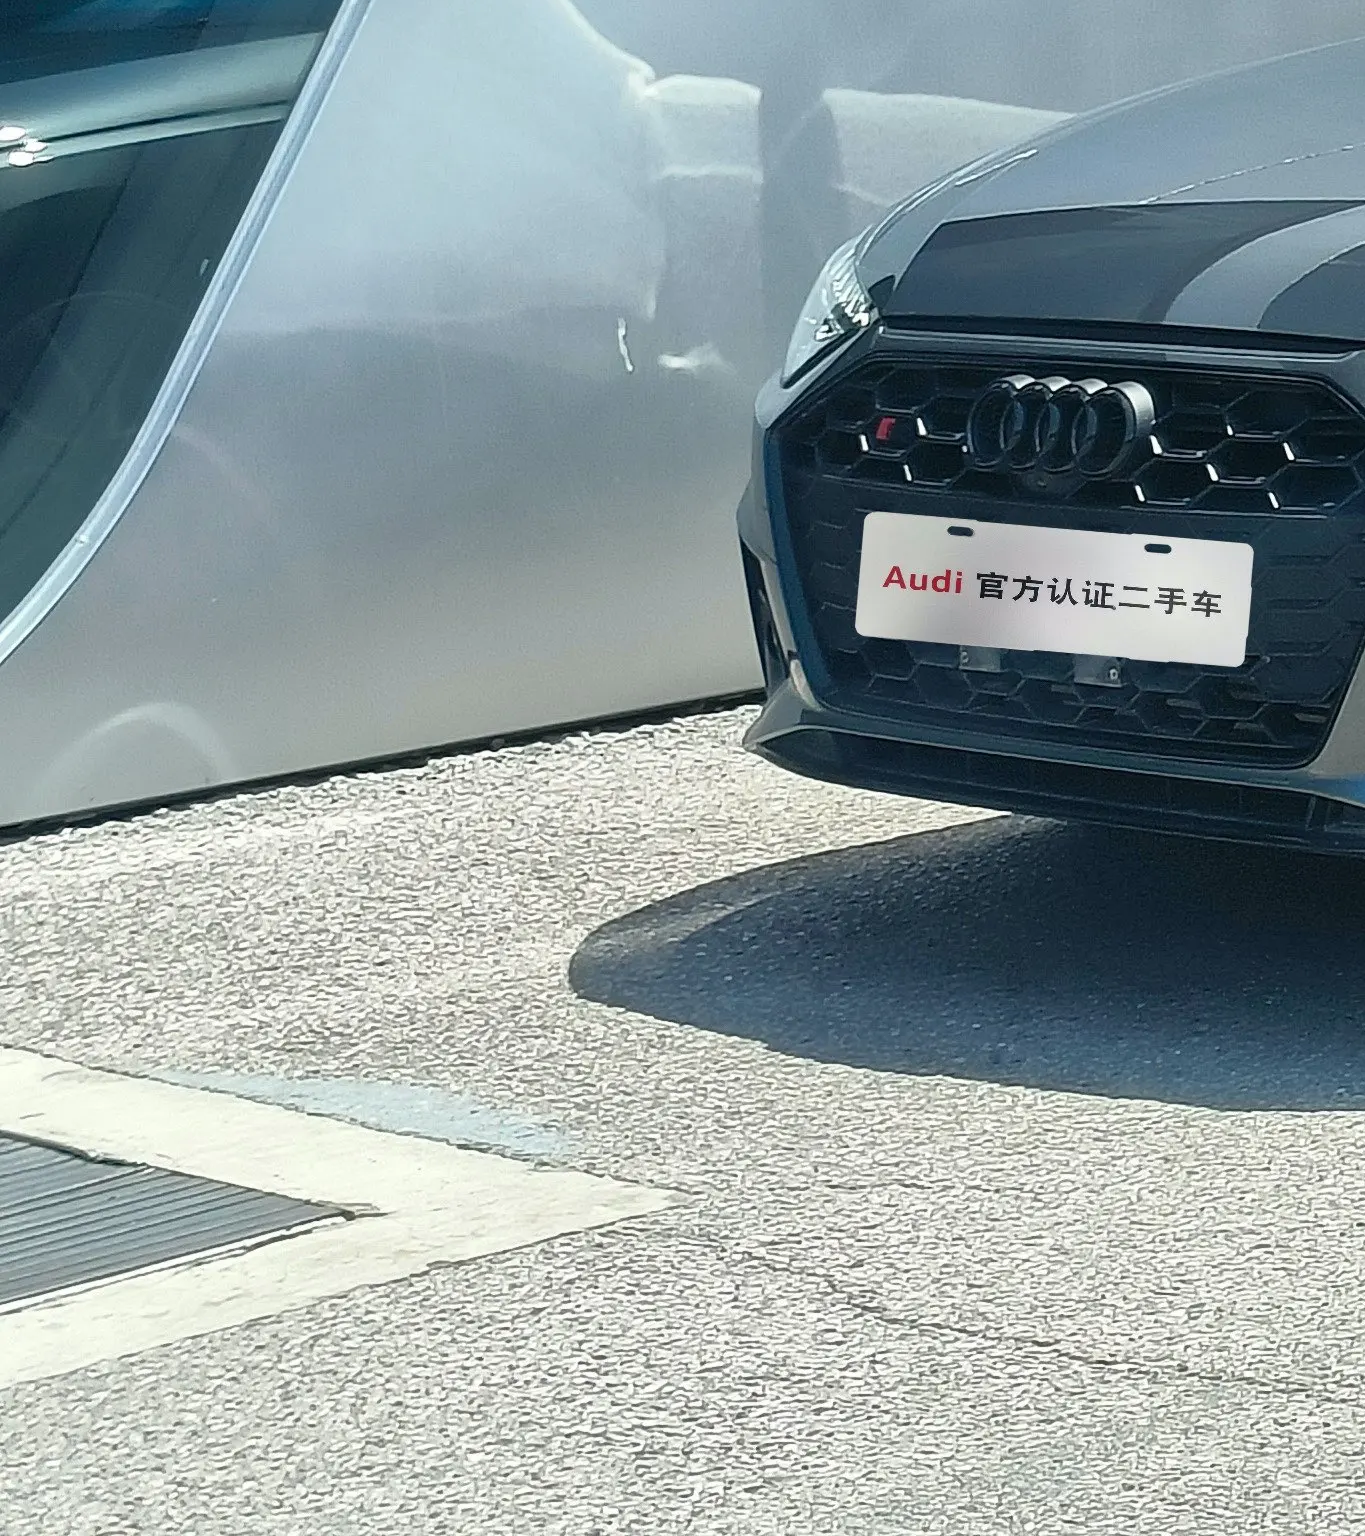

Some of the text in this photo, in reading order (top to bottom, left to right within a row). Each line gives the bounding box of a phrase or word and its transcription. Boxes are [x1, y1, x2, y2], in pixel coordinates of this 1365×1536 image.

[882, 566, 1222, 618] Audi 官方认证二手车
